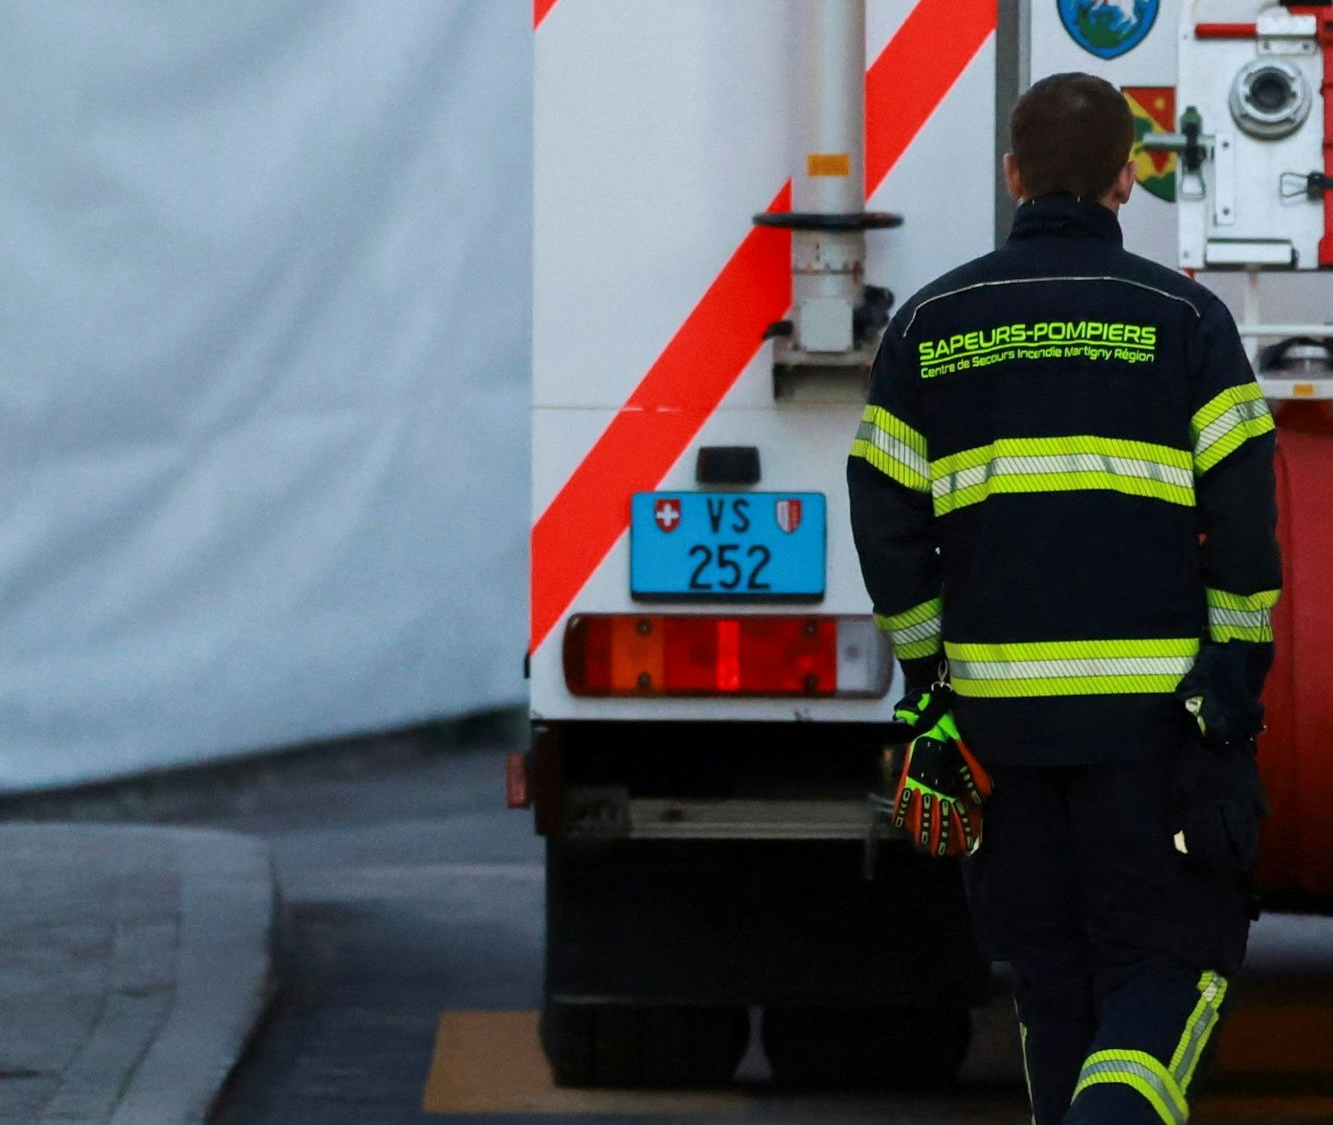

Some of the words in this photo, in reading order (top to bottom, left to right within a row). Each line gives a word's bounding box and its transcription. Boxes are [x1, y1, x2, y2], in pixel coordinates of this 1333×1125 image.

[919, 321, 1157, 361] SAPEURS-POMPIERS
[921, 363, 956, 379] Centre
[957, 358, 970, 370] de
[972, 349, 1015, 367] Secours
[1017, 346, 1062, 360] Incendie
[1064, 345, 1112, 360] Martigny
[1114, 348, 1155, 363] Région
[707, 498, 751, 534] VS
[688, 544, 772, 590] 252
